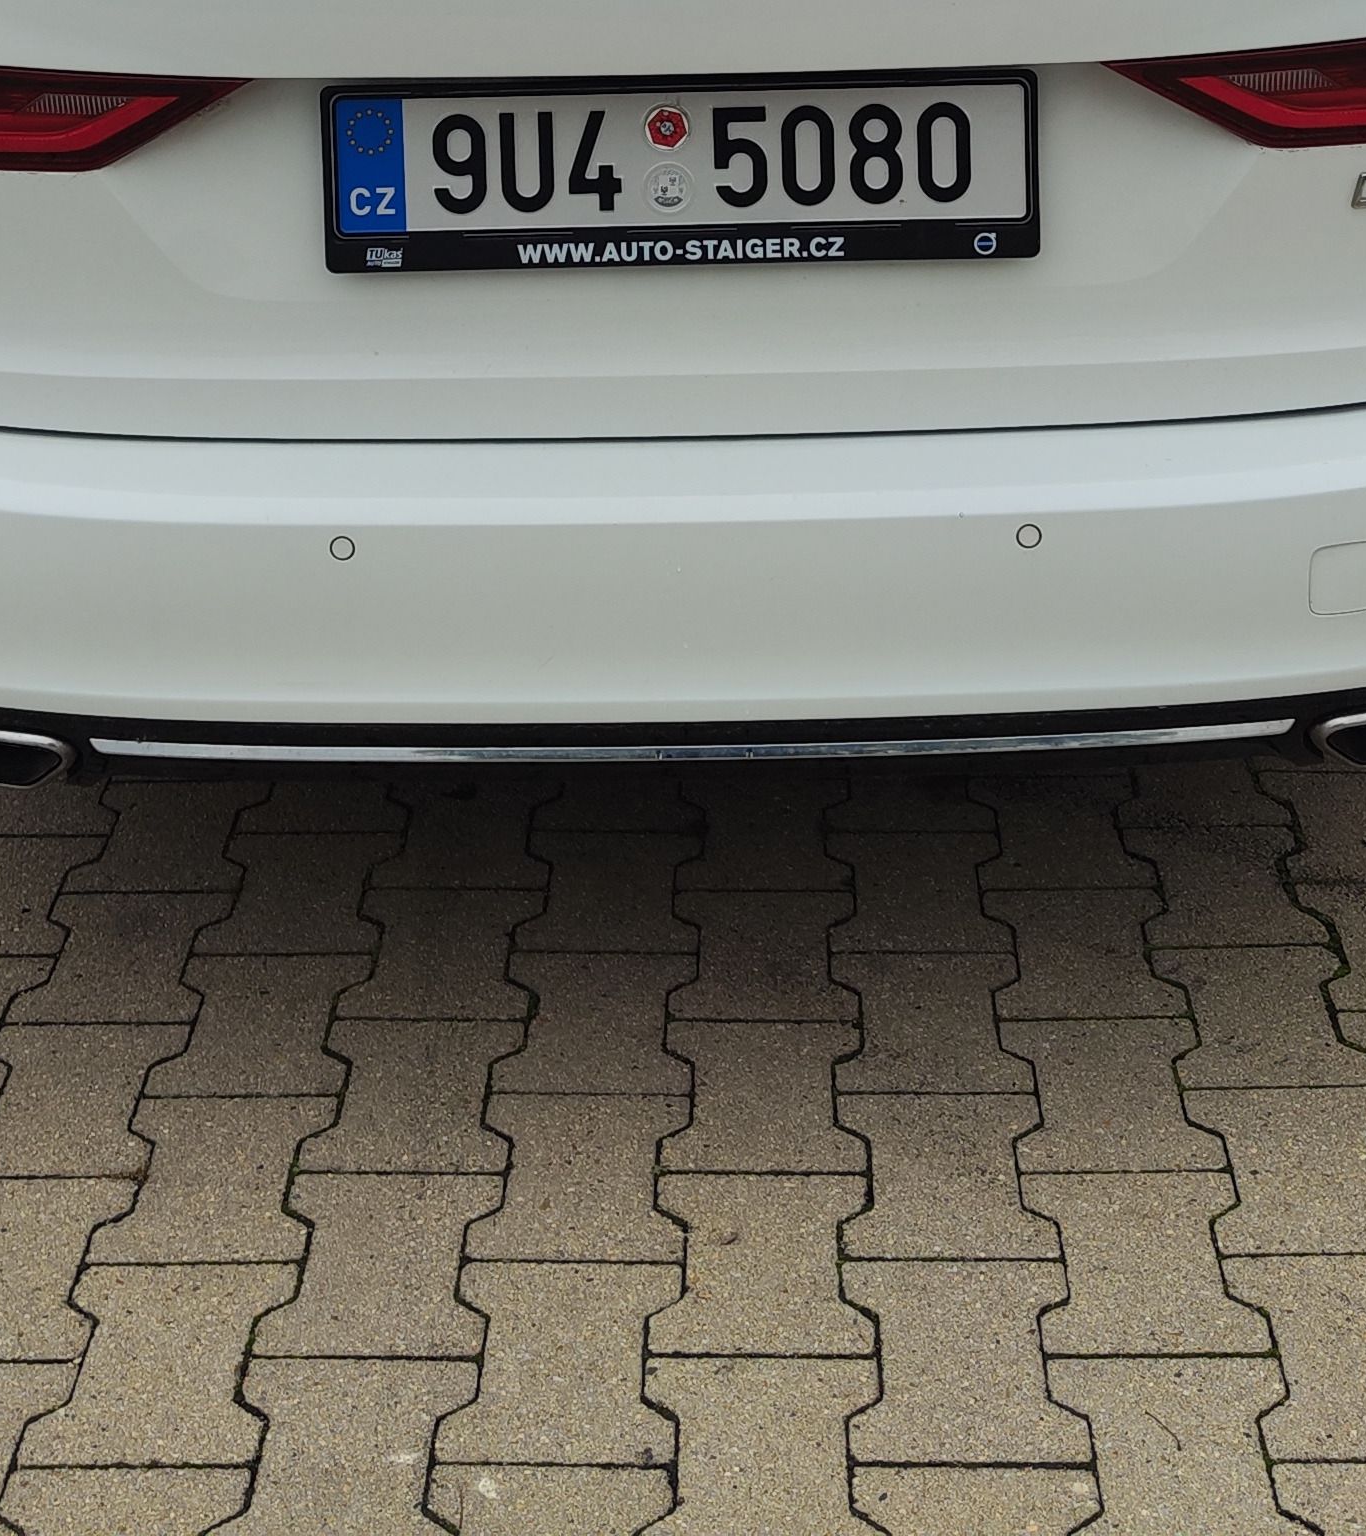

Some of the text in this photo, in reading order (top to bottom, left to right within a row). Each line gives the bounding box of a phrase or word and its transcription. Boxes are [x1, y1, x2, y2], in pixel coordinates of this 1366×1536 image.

[432, 101, 973, 216] 9U4 5080
[349, 185, 397, 218] CZ
[517, 235, 846, 265] WWW.AUTO-STAIGER.CZ
